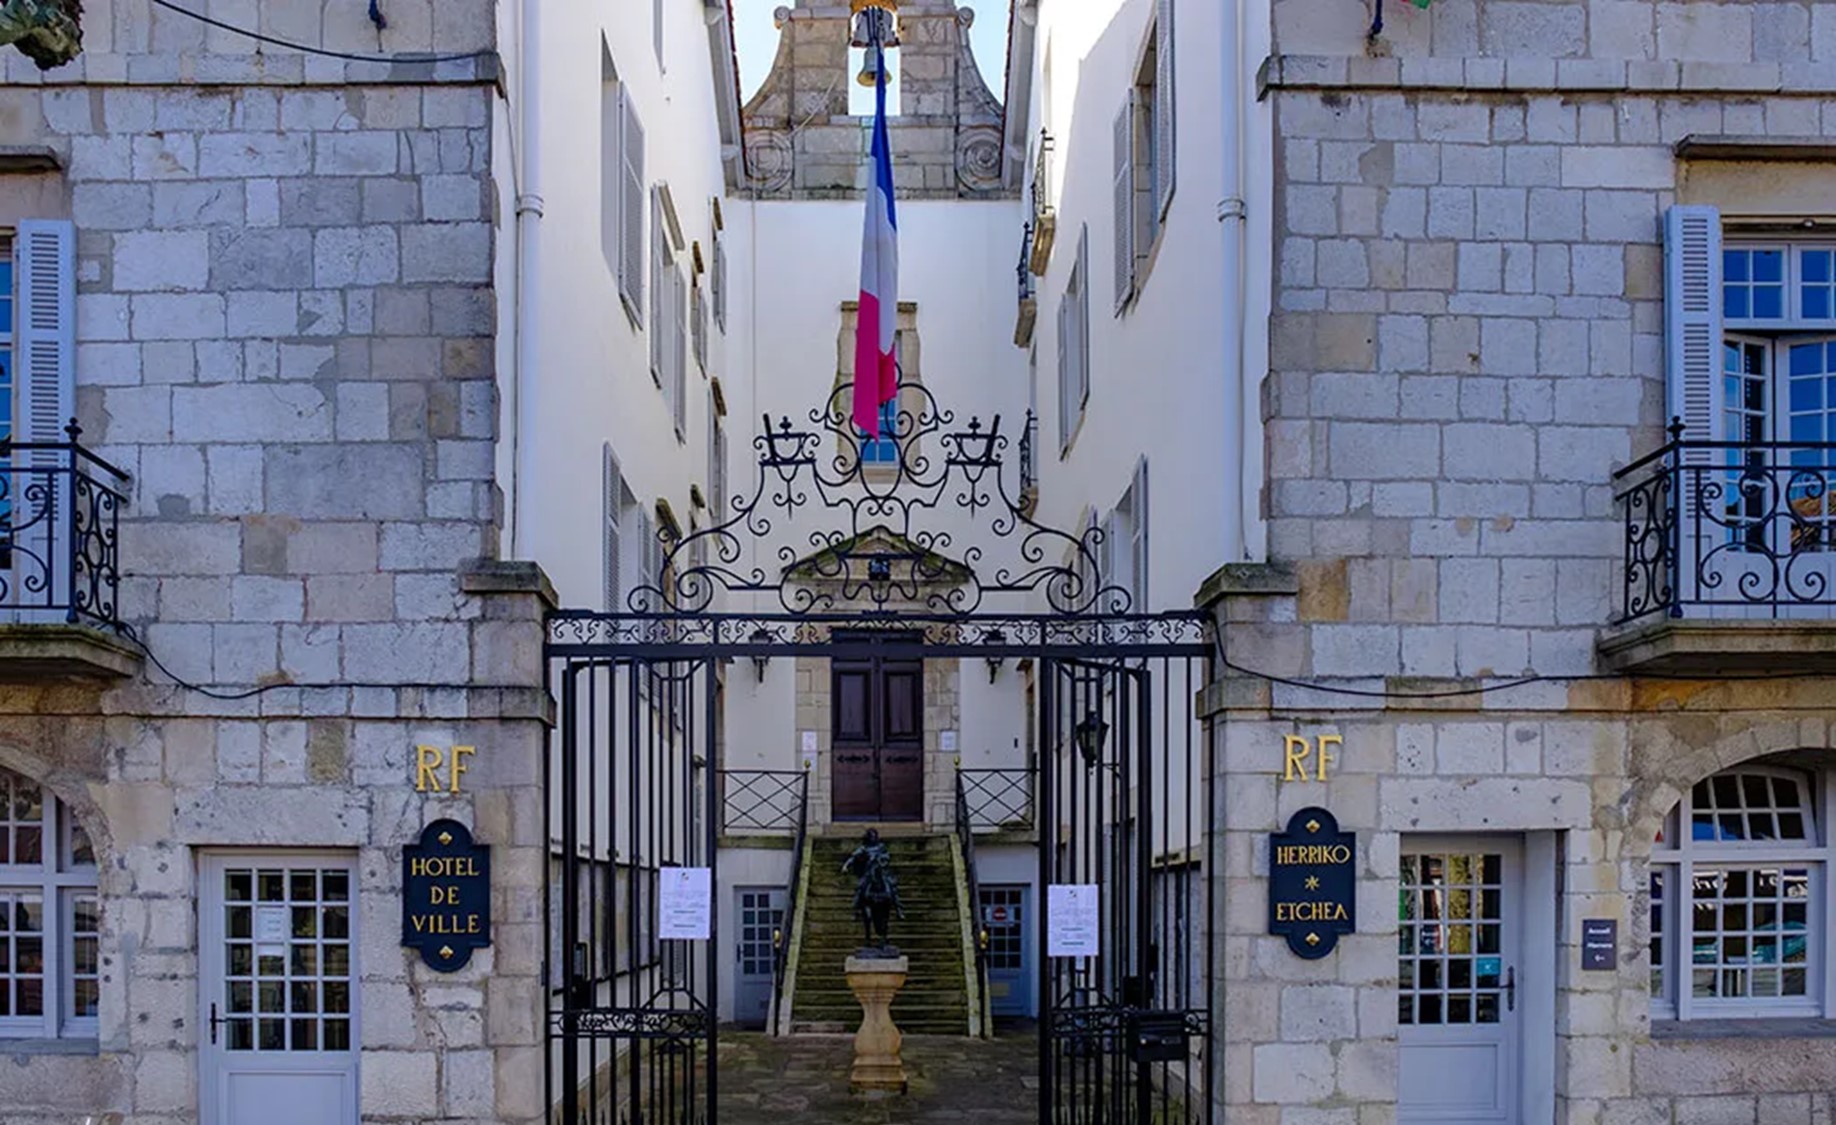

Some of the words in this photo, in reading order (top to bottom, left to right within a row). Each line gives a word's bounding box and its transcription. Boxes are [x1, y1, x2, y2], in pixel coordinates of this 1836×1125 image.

[415, 743, 476, 794] RF
[1283, 733, 1343, 783] RF
[1276, 844, 1351, 866] HERRIKO
[411, 856, 480, 877] HOTEL
[430, 885, 460, 905] DE
[1276, 902, 1348, 921] ETCHEA
[411, 914, 481, 934] VILLE
